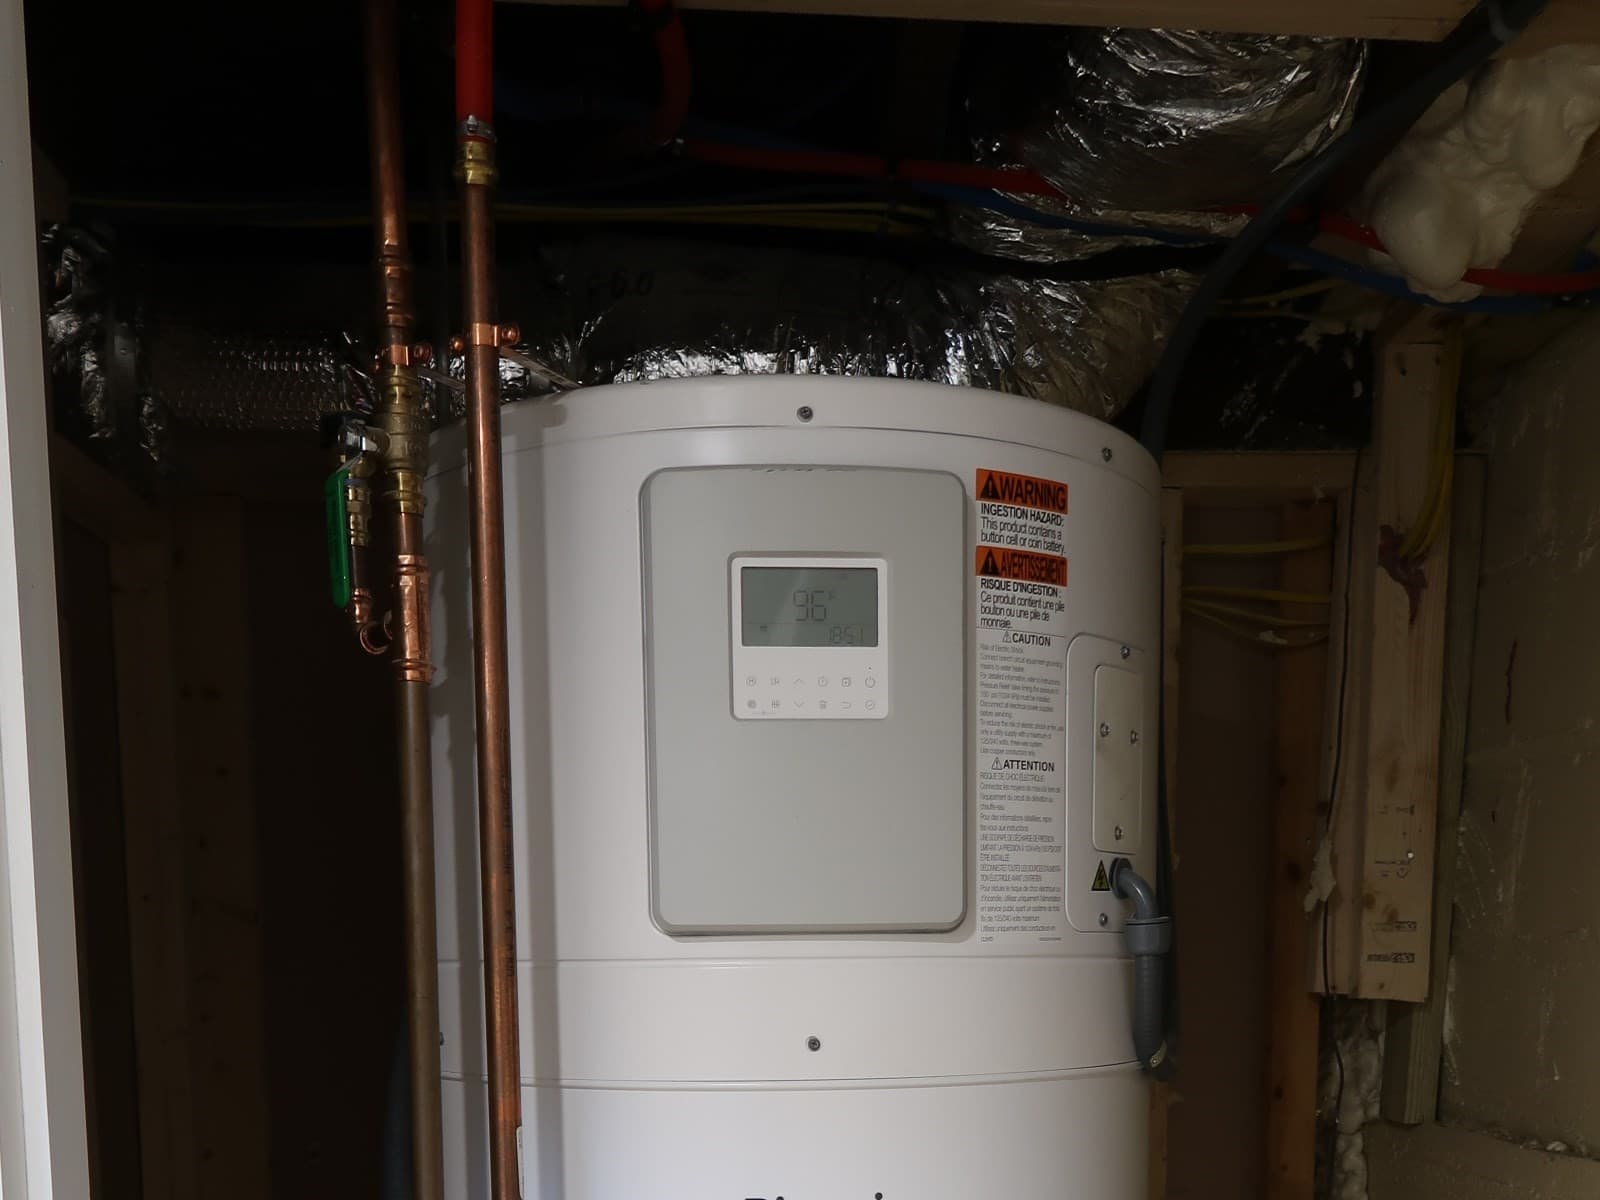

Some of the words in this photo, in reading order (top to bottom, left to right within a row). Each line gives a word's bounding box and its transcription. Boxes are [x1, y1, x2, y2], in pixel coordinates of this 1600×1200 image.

[1000, 474, 1066, 511] WARNING
[981, 503, 1028, 520] INGESTION
[1030, 510, 1064, 527] HAZARD:
[981, 516, 998, 530] This
[1000, 520, 1027, 533] product
[1028, 525, 1056, 540] contains
[1057, 531, 1062, 540] a
[981, 531, 1004, 544] button
[1006, 534, 1018, 546] cell
[1020, 537, 1027, 546] or
[1028, 538, 1042, 550] coin
[981, 578, 1010, 591] RISQUE
[1013, 582, 1057, 597] D'INGESTION
[793, 590, 827, 622] 96
[981, 591, 991, 602] Ce
[993, 594, 1016, 605] produit
[1017, 597, 1041, 608] contient
[1043, 601, 1054, 610] une
[1055, 601, 1065, 613] pile
[981, 604, 1004, 616] bouton
[1006, 608, 1015, 618] ou
[1016, 610, 1029, 620] une
[1030, 609, 1041, 621] pile
[1042, 611, 1050, 621] de
[1012, 633, 1051, 646] CAUTION
[1003, 759, 1055, 772] ATTENTION
